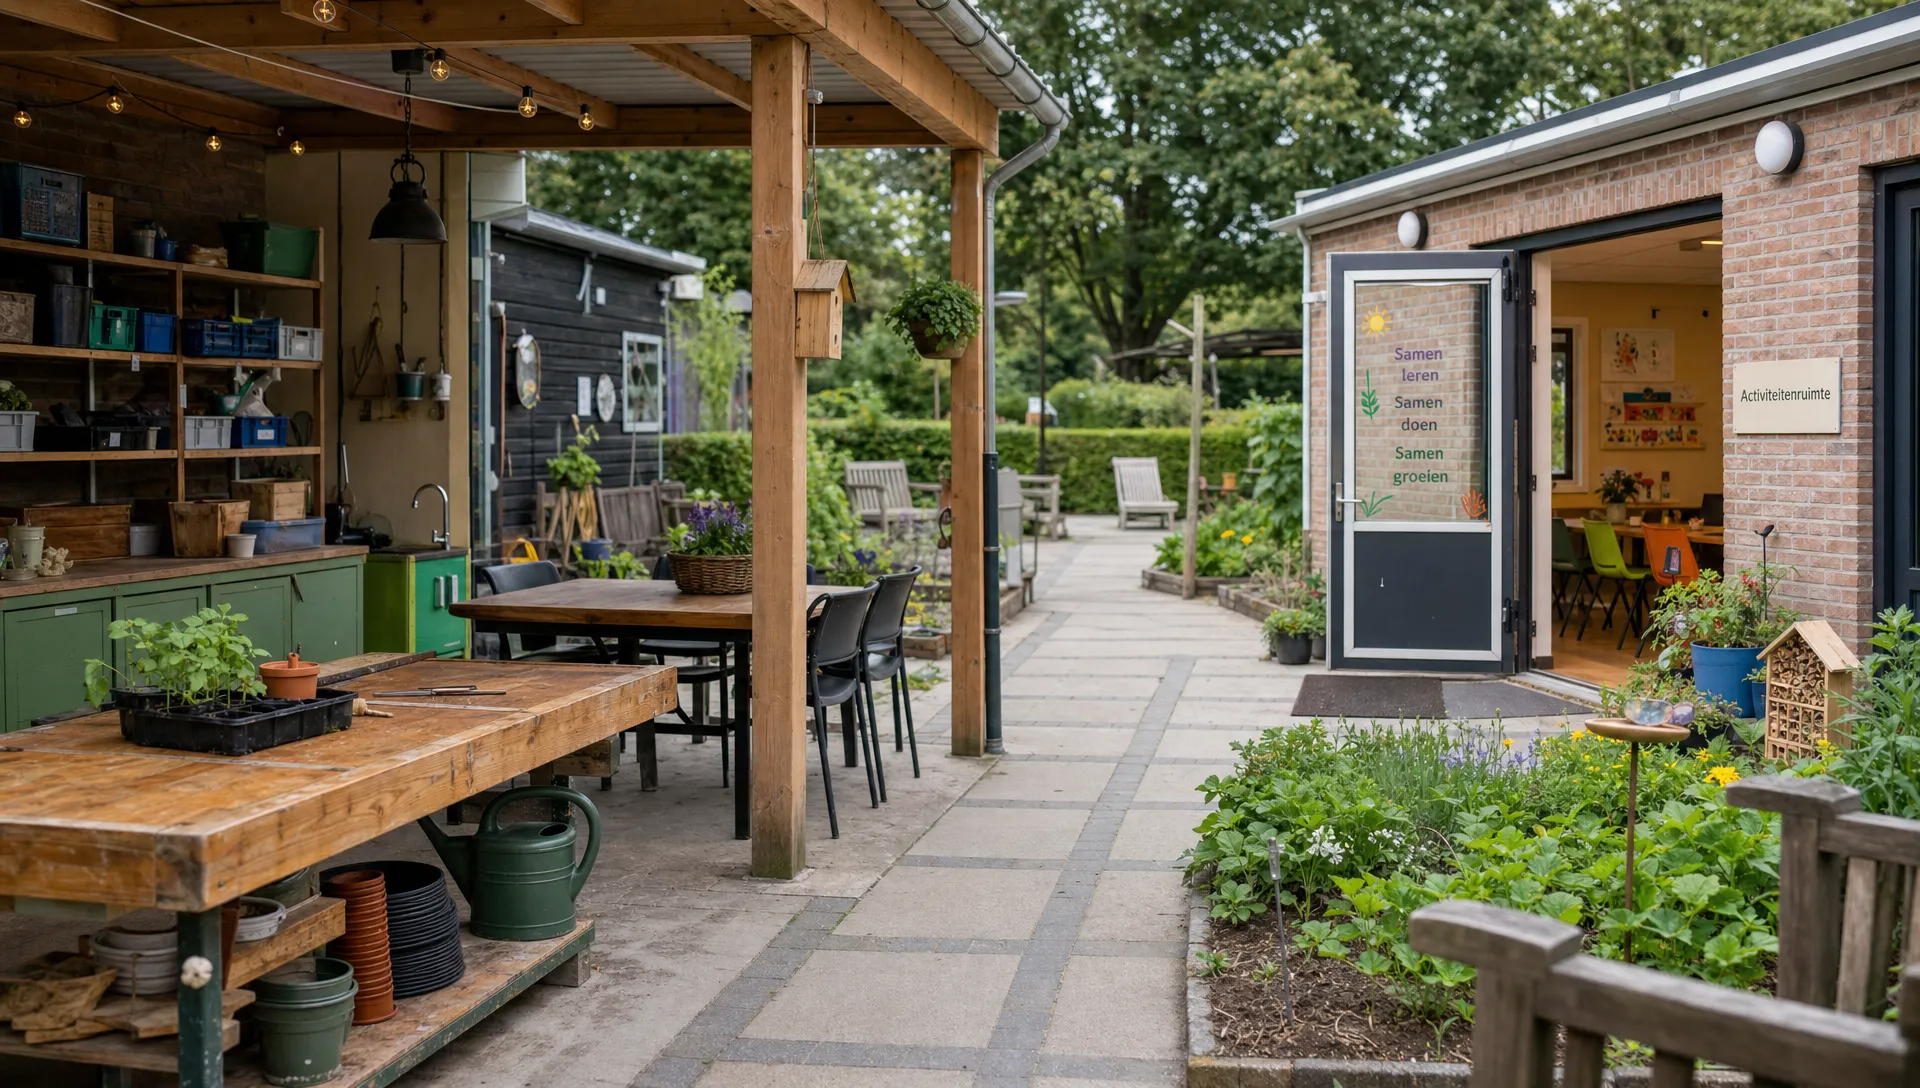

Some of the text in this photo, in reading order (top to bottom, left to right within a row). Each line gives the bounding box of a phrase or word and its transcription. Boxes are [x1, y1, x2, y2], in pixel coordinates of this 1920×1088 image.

[1394, 347, 1443, 360] Samen
[1402, 368, 1439, 382] leren
[1740, 387, 1831, 402] Activiteitenruimte
[1394, 396, 1443, 409] Samen
[1401, 417, 1438, 431] doen
[1395, 446, 1444, 460] Samen
[1393, 469, 1448, 486] groeien
